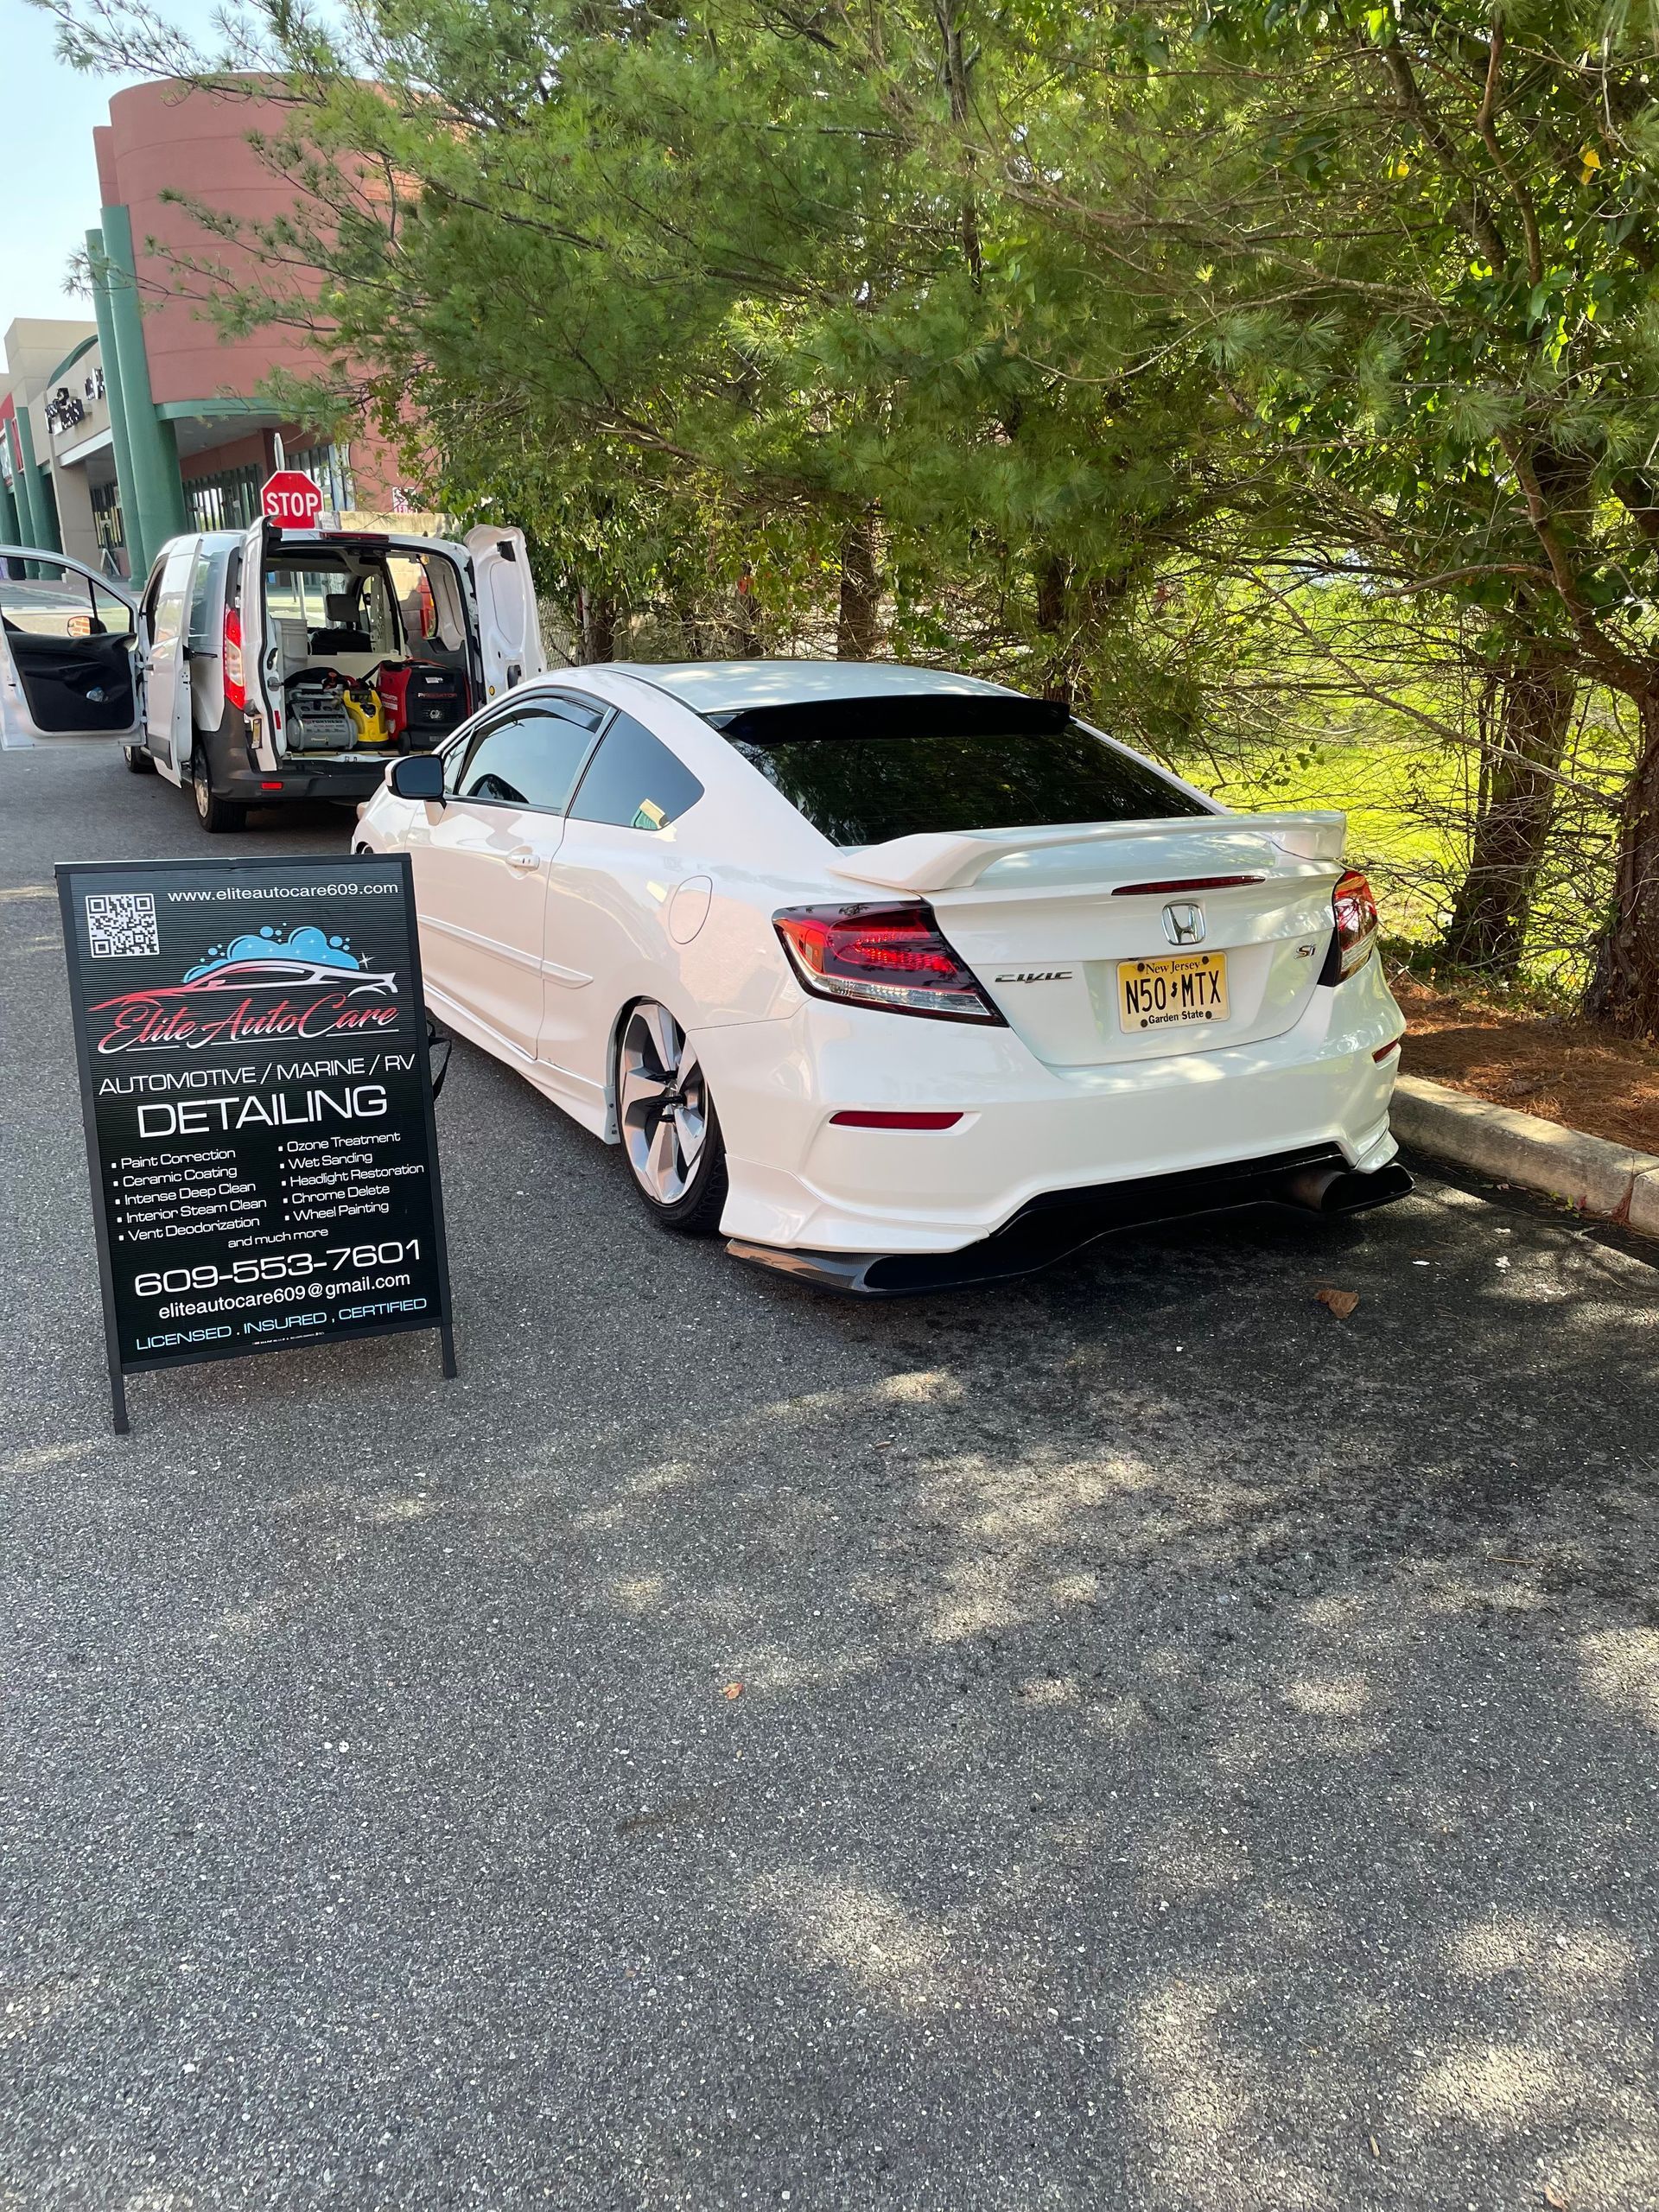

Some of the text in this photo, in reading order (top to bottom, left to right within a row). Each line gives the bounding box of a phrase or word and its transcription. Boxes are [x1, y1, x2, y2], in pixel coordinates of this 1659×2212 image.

[266, 492, 319, 518] STOP
[167, 883, 398, 903] www.eliteautocare609.com
[995, 970, 1073, 983] CIVIC
[1146, 960, 1200, 975] New Jersey
[1126, 969, 1221, 1014] N50 MTX
[1148, 1009, 1204, 1025] Garden State
[99, 1066, 257, 1096] AUTOMOTIVE
[276, 1058, 365, 1081] MARINE
[385, 1053, 416, 1072] RV
[137, 1084, 388, 1139] DETAILING
[287, 1132, 401, 1153] Ozone Treatment
[121, 1148, 236, 1169] Paint Correction
[288, 1152, 373, 1170] Wet Sanding
[123, 1166, 238, 1187] Ceramic Coating
[290, 1163, 424, 1187] Headlight Restoration
[124, 1183, 257, 1205] Intense Deep Clean
[292, 1185, 390, 1205] Chrome Delete
[126, 1198, 267, 1224] Interior Steam Clean
[293, 1201, 389, 1221] Wheel Painting
[128, 1217, 260, 1242] Vent Deodorization
[228, 1228, 328, 1249] and much more
[135, 1239, 421, 1297] 609-553-7601
[137, 1325, 232, 1351] LICENSED
[244, 1312, 327, 1335] INSURED
[339, 1297, 428, 1321] CERTIFIED
